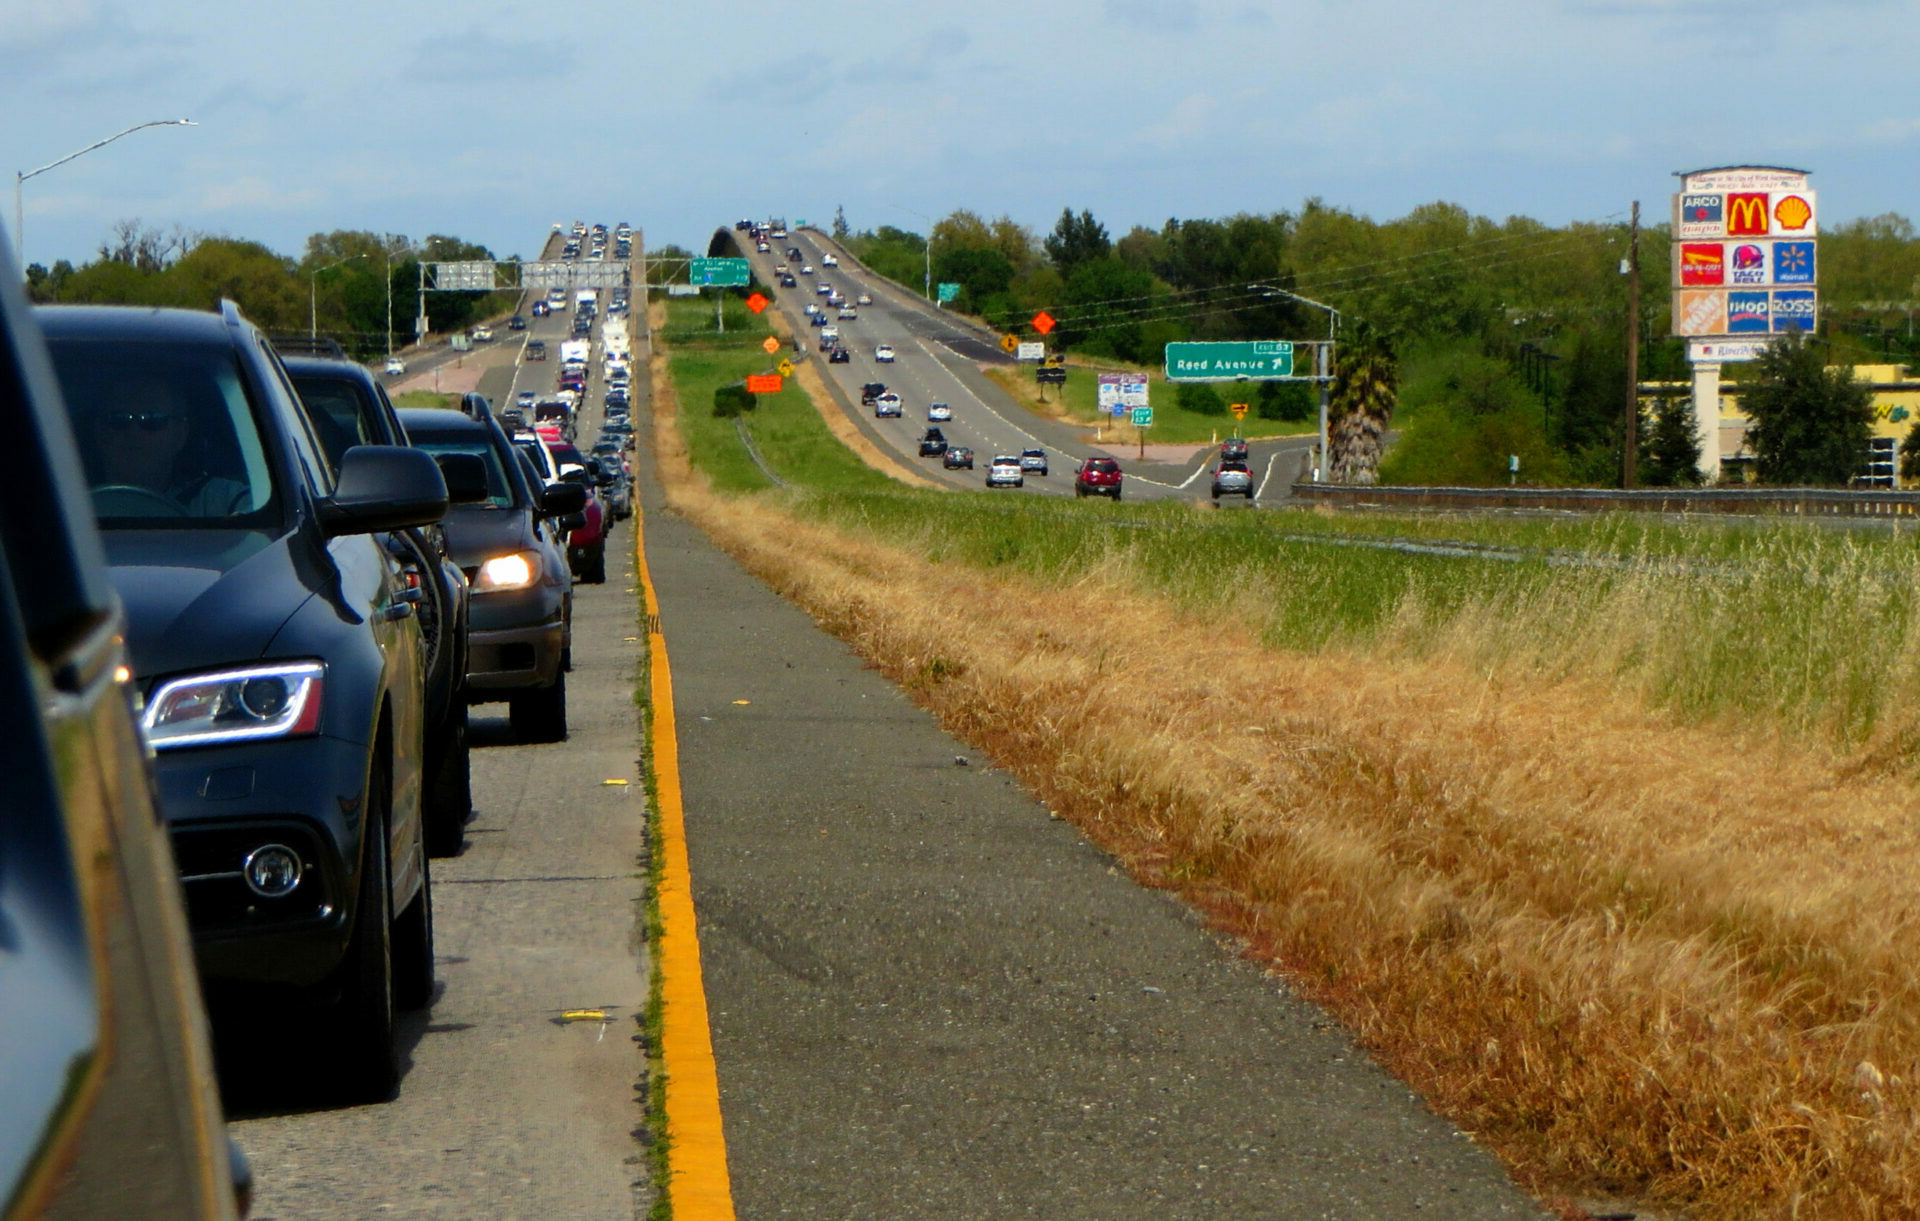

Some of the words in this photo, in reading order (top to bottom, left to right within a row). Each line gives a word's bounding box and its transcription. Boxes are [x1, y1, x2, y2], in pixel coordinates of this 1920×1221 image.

[1684, 196, 1719, 207] ARCO
[1773, 299, 1814, 312] ROSS
[1177, 360, 1208, 370] Reed
[1214, 360, 1264, 370] Avenue
